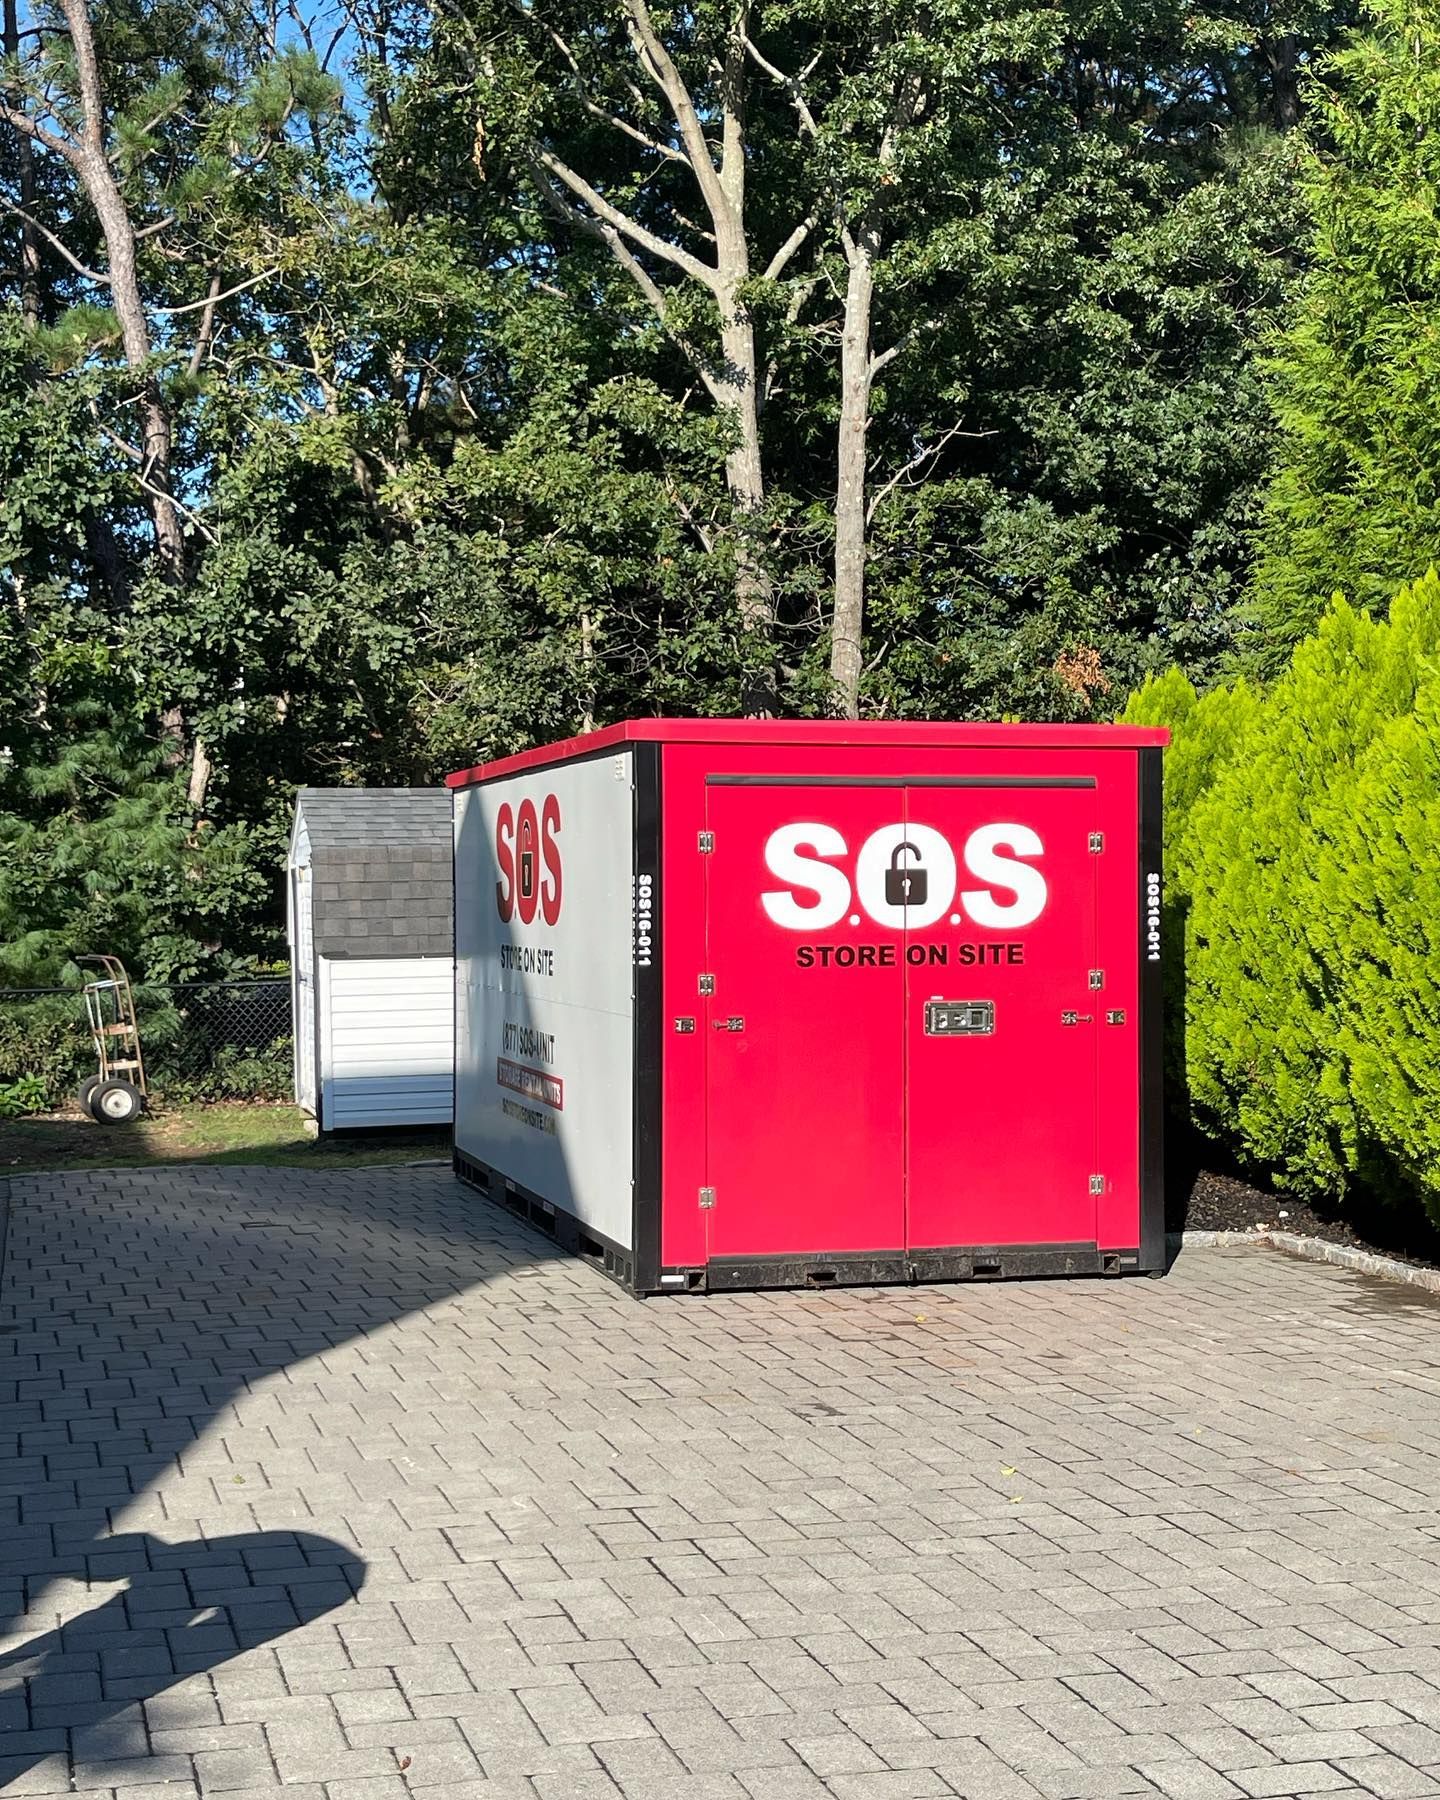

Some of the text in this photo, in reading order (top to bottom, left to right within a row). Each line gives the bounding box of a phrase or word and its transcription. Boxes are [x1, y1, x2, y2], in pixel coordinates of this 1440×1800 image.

[760, 822, 1047, 930] S.O.S
[638, 873, 653, 966] SOS16-011
[1147, 872, 1161, 960] SOS16-011
[501, 945, 553, 976] STORE ON SITE
[796, 943, 1025, 968] STORE ON SITE
[520, 1027, 554, 1064] SOS-UNIT
